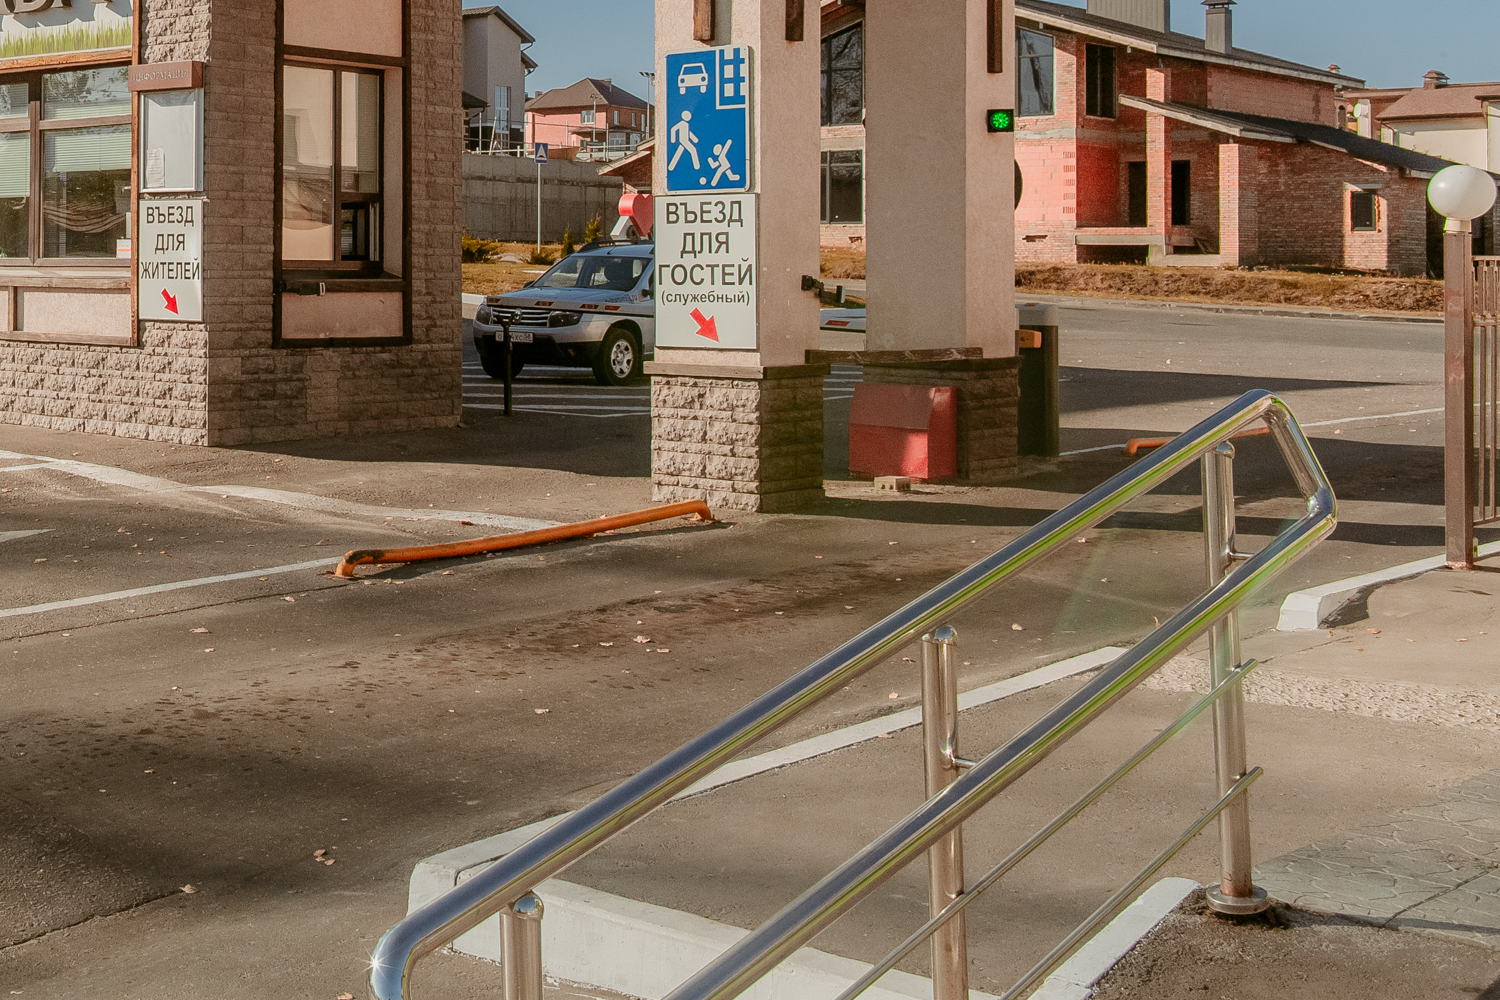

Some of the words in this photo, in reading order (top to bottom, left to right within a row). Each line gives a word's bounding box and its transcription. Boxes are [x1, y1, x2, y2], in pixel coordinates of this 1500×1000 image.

[146, 205, 194, 227] ВЪЕЗД
[666, 200, 744, 227] ВЪЕЗД
[154, 233, 186, 255] ДЛЯ
[680, 231, 730, 259] ДЛЯ
[140, 257, 200, 281] ЖИТЕЛЕЙ
[658, 257, 753, 286] ГОСТЕЙ
[661, 290, 750, 306] (служебный)
